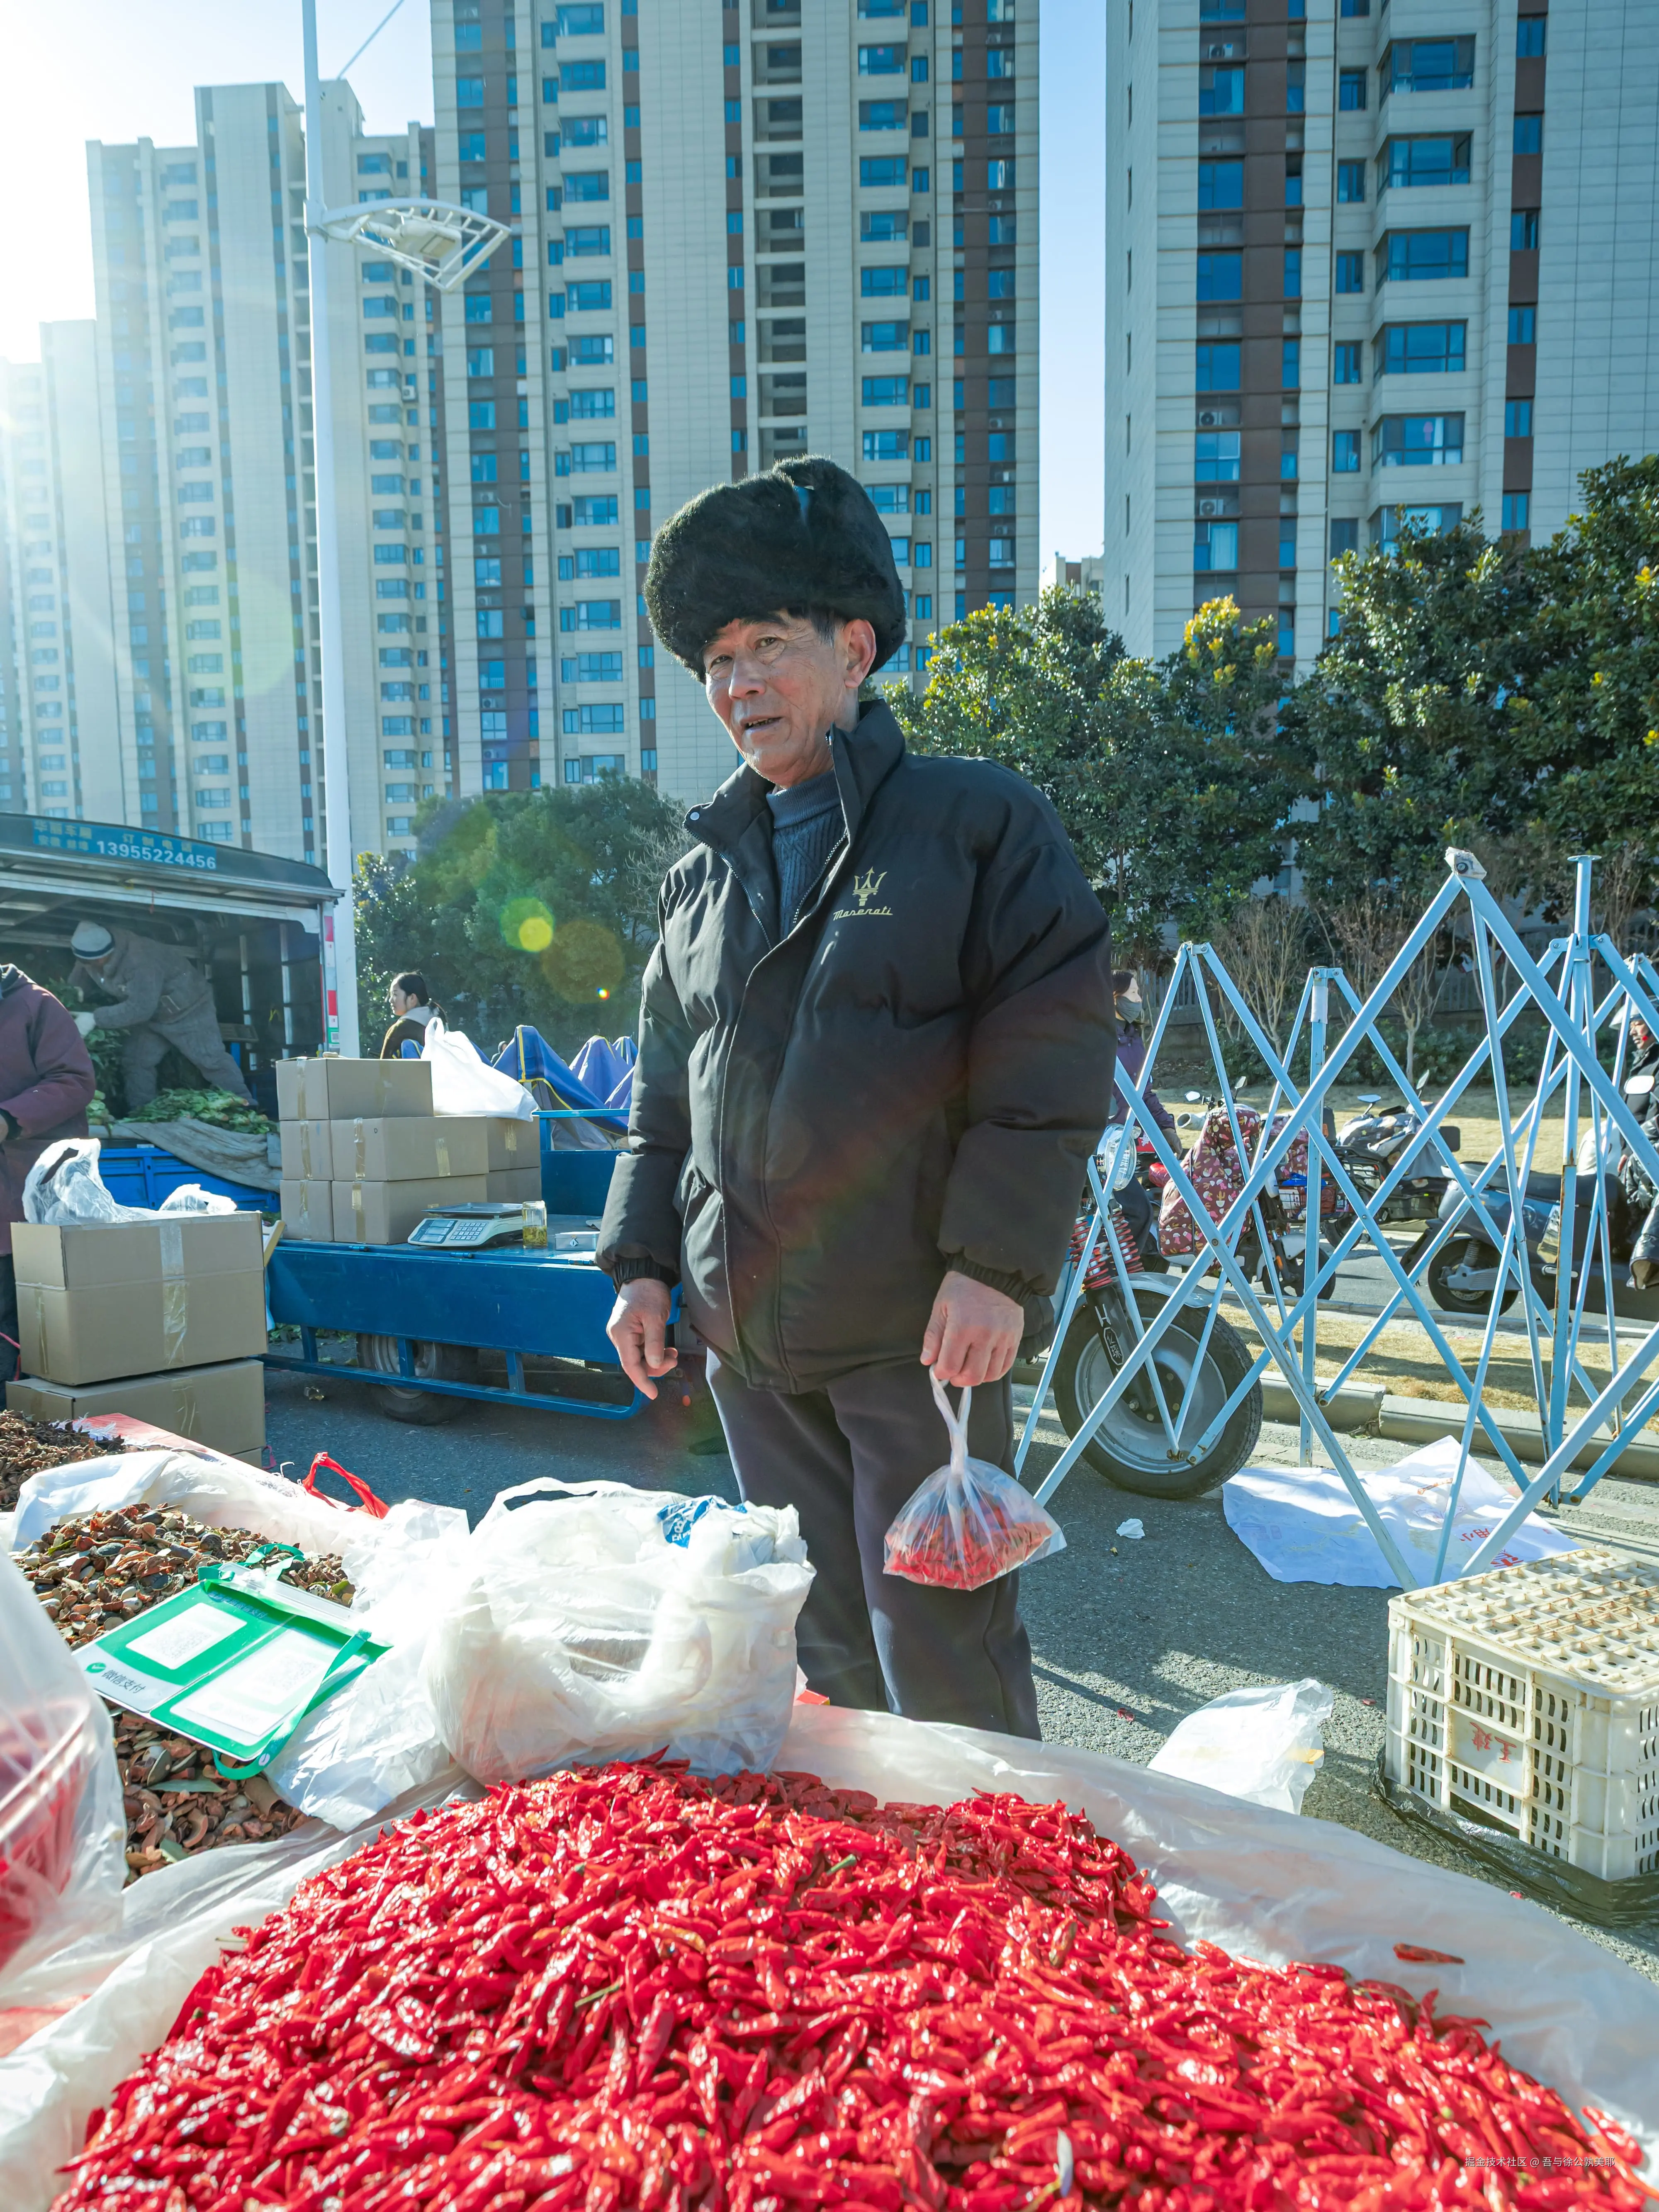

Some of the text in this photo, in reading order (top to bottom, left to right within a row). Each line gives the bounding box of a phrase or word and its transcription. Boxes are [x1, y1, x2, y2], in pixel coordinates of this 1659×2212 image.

[97, 841, 216, 869] 13955224456
[833, 906, 893, 921] Maserati
[101, 1669, 146, 1694] 微信支付
